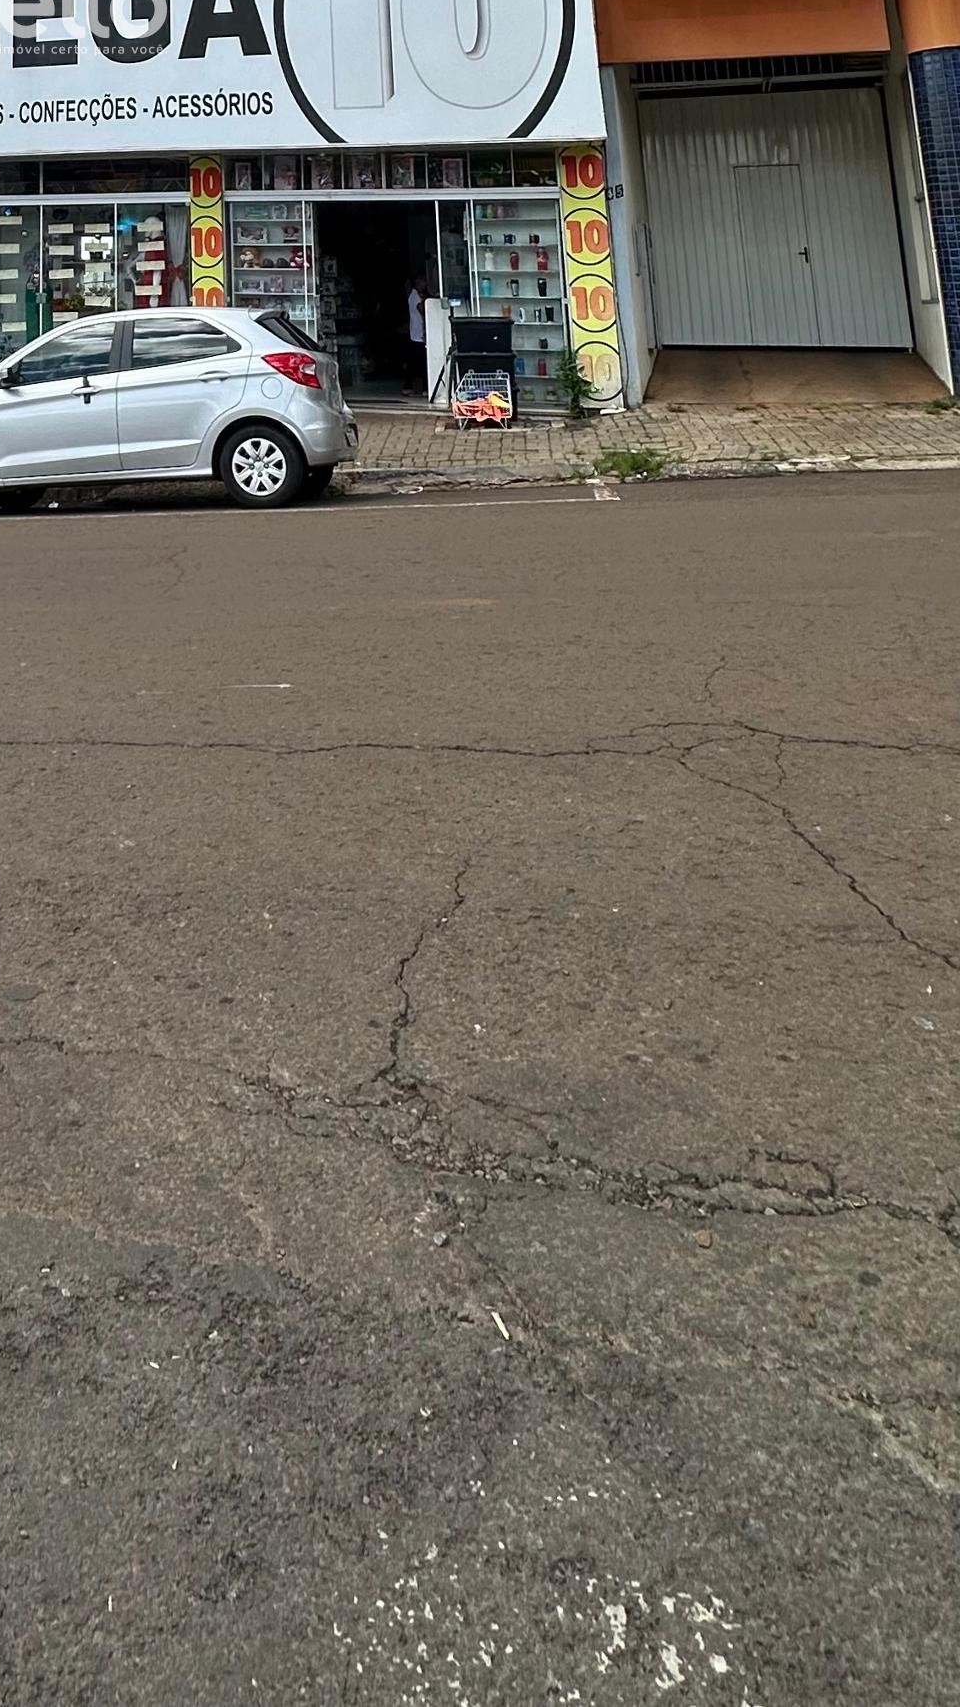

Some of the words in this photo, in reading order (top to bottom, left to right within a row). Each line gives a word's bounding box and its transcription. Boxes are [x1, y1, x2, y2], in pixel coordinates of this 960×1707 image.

[18, 93, 137, 127] CONFECÇÕES
[152, 87, 274, 119] ACESSÓRIOS
[190, 167, 222, 198] 10
[561, 154, 604, 189] 10
[191, 226, 224, 259] 10
[566, 219, 610, 254] 10
[193, 287, 224, 306] 10
[572, 285, 616, 322] 10
